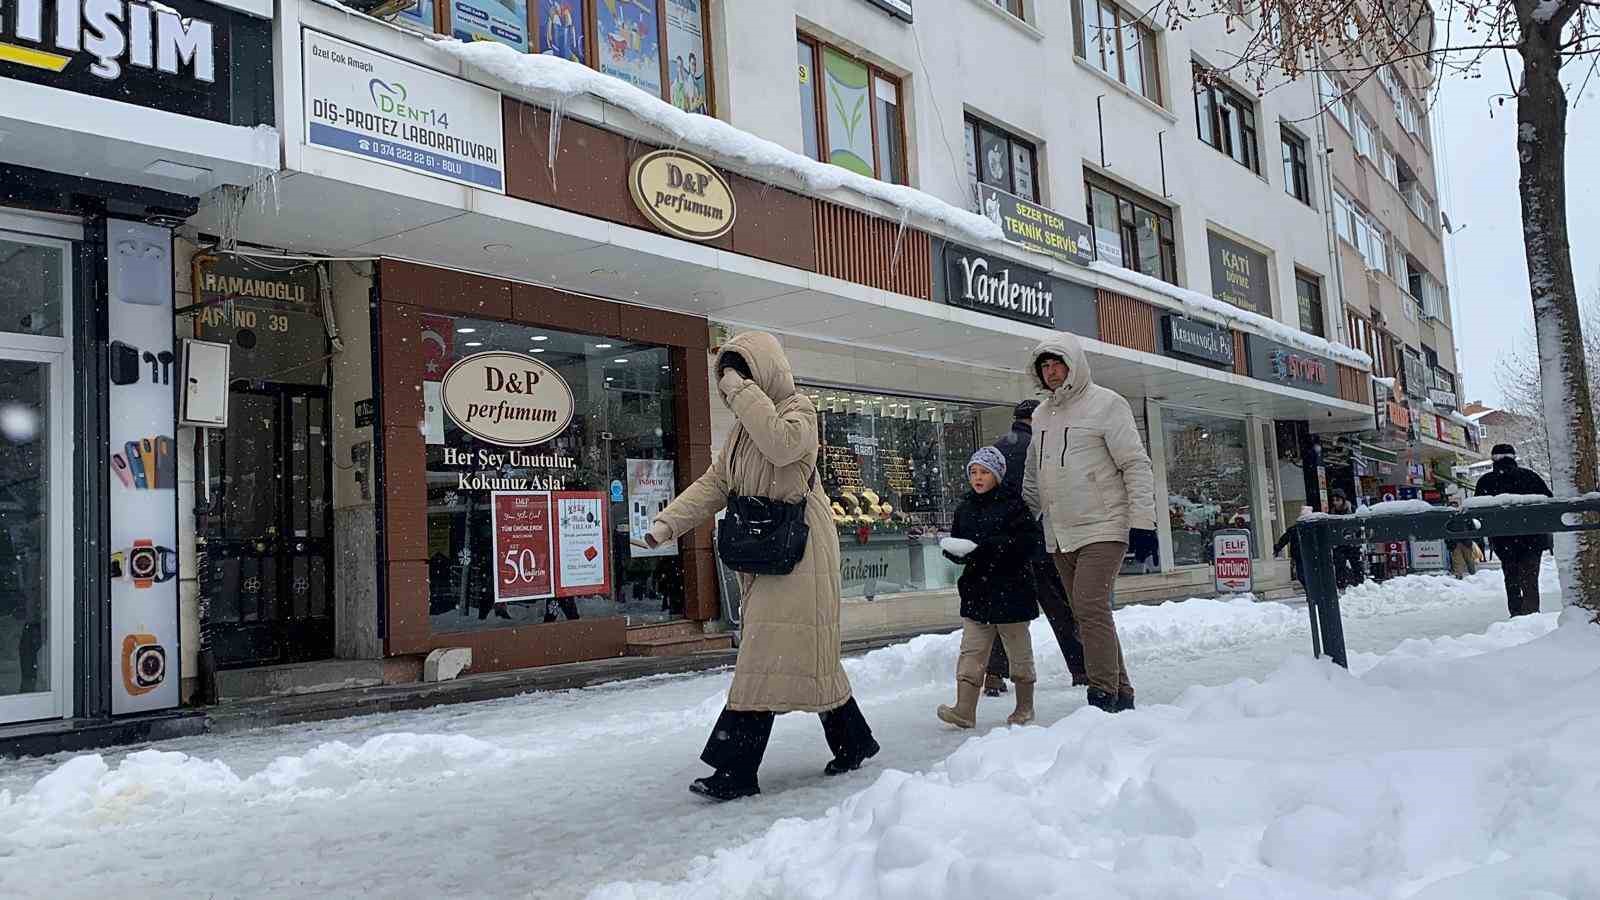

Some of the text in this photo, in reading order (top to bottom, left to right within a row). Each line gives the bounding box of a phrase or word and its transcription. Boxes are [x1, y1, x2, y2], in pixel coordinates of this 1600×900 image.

[312, 44, 374, 73] Özel Çok Amaçlı
[313, 98, 497, 164] DİŞ-PROTEZ LABORATUVARI
[380, 145, 395, 158] 374
[396, 148, 412, 162] 222
[414, 152, 425, 165] 22
[426, 155, 435, 168] 61
[442, 158, 462, 175] BOLU
[654, 191, 723, 220] perfumum
[1015, 203, 1064, 231] SEZER TECH
[1004, 215, 1044, 242] TEKNİK
[1044, 231, 1078, 254] SERVİS
[961, 256, 1053, 318] Yardemir
[268, 314, 289, 333] 39
[465, 400, 557, 424] perfumum
[443, 447, 577, 470] Her Şey Unutulur,
[458, 473, 566, 491] Kokunuz Asla!
[1217, 560, 1249, 577] TÜTÜNCÜ
